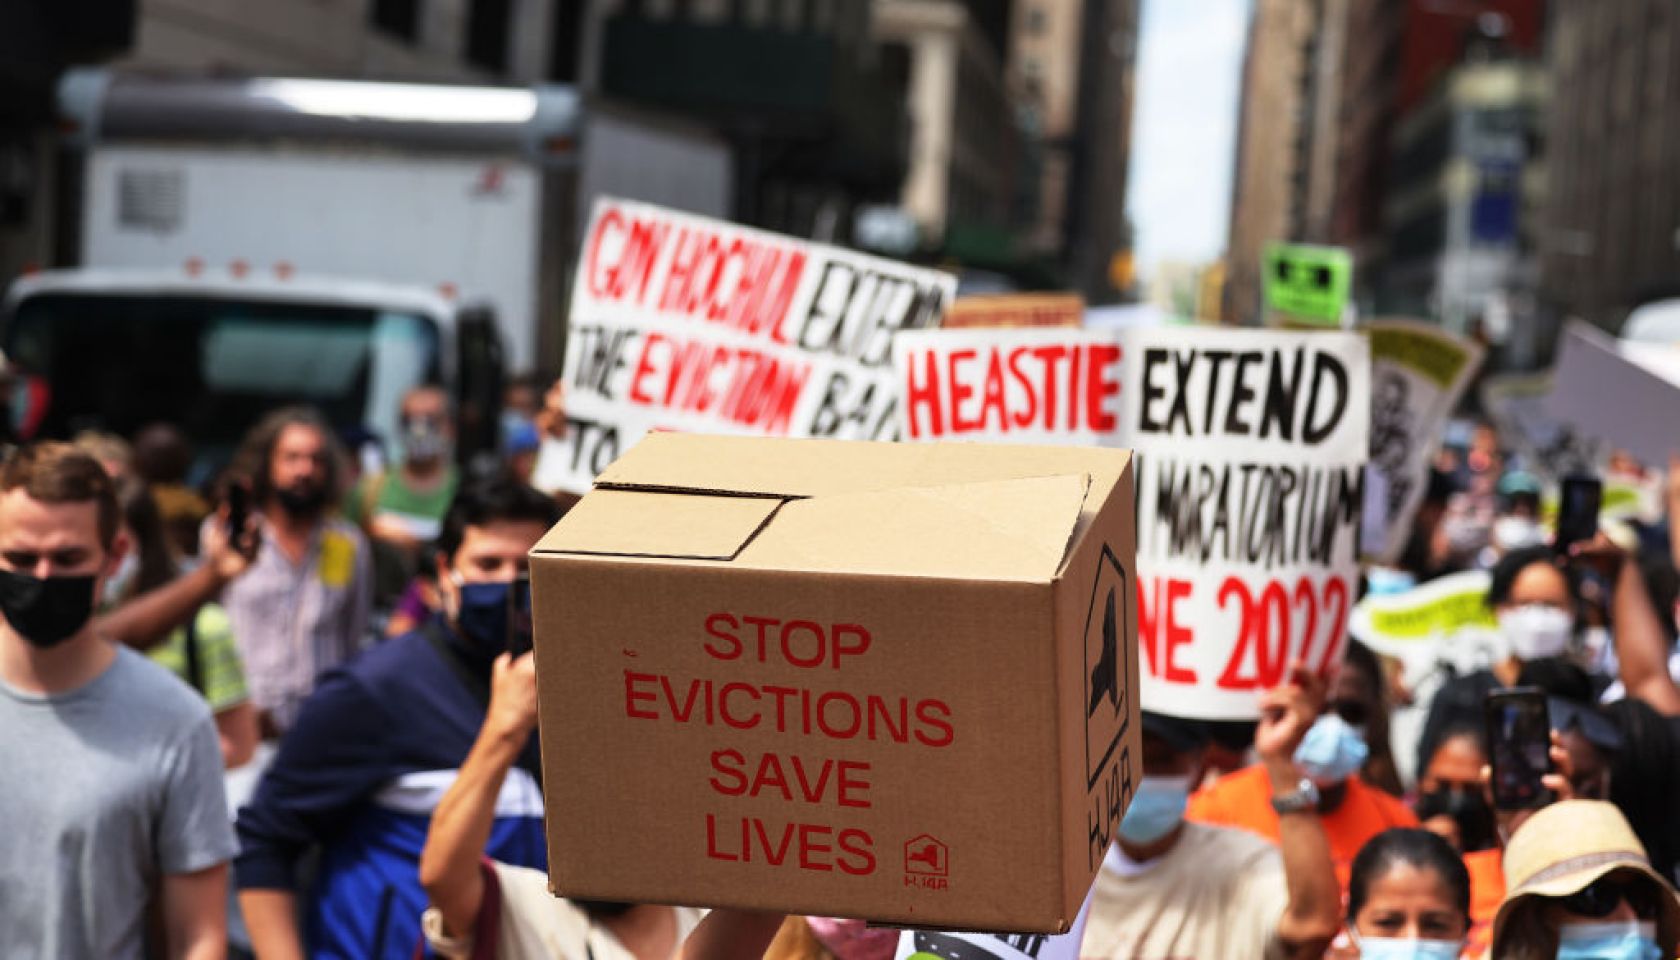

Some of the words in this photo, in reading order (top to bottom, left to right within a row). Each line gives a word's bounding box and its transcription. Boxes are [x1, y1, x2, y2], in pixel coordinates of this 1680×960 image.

[658, 228, 806, 343] HOCHUL
[573, 324, 638, 400] THE
[629, 332, 812, 434] EVICTION
[908, 345, 1121, 438] HEASTIE
[1139, 345, 1349, 444] EXTEND
[562, 416, 620, 476] TO
[704, 613, 872, 669] STOP
[1217, 574, 1347, 690] 2022
[624, 669, 954, 747] EVICTIONS
[709, 748, 872, 808] SAVE
[1087, 744, 1133, 873] HJ4A
[706, 814, 877, 876] LIVES
